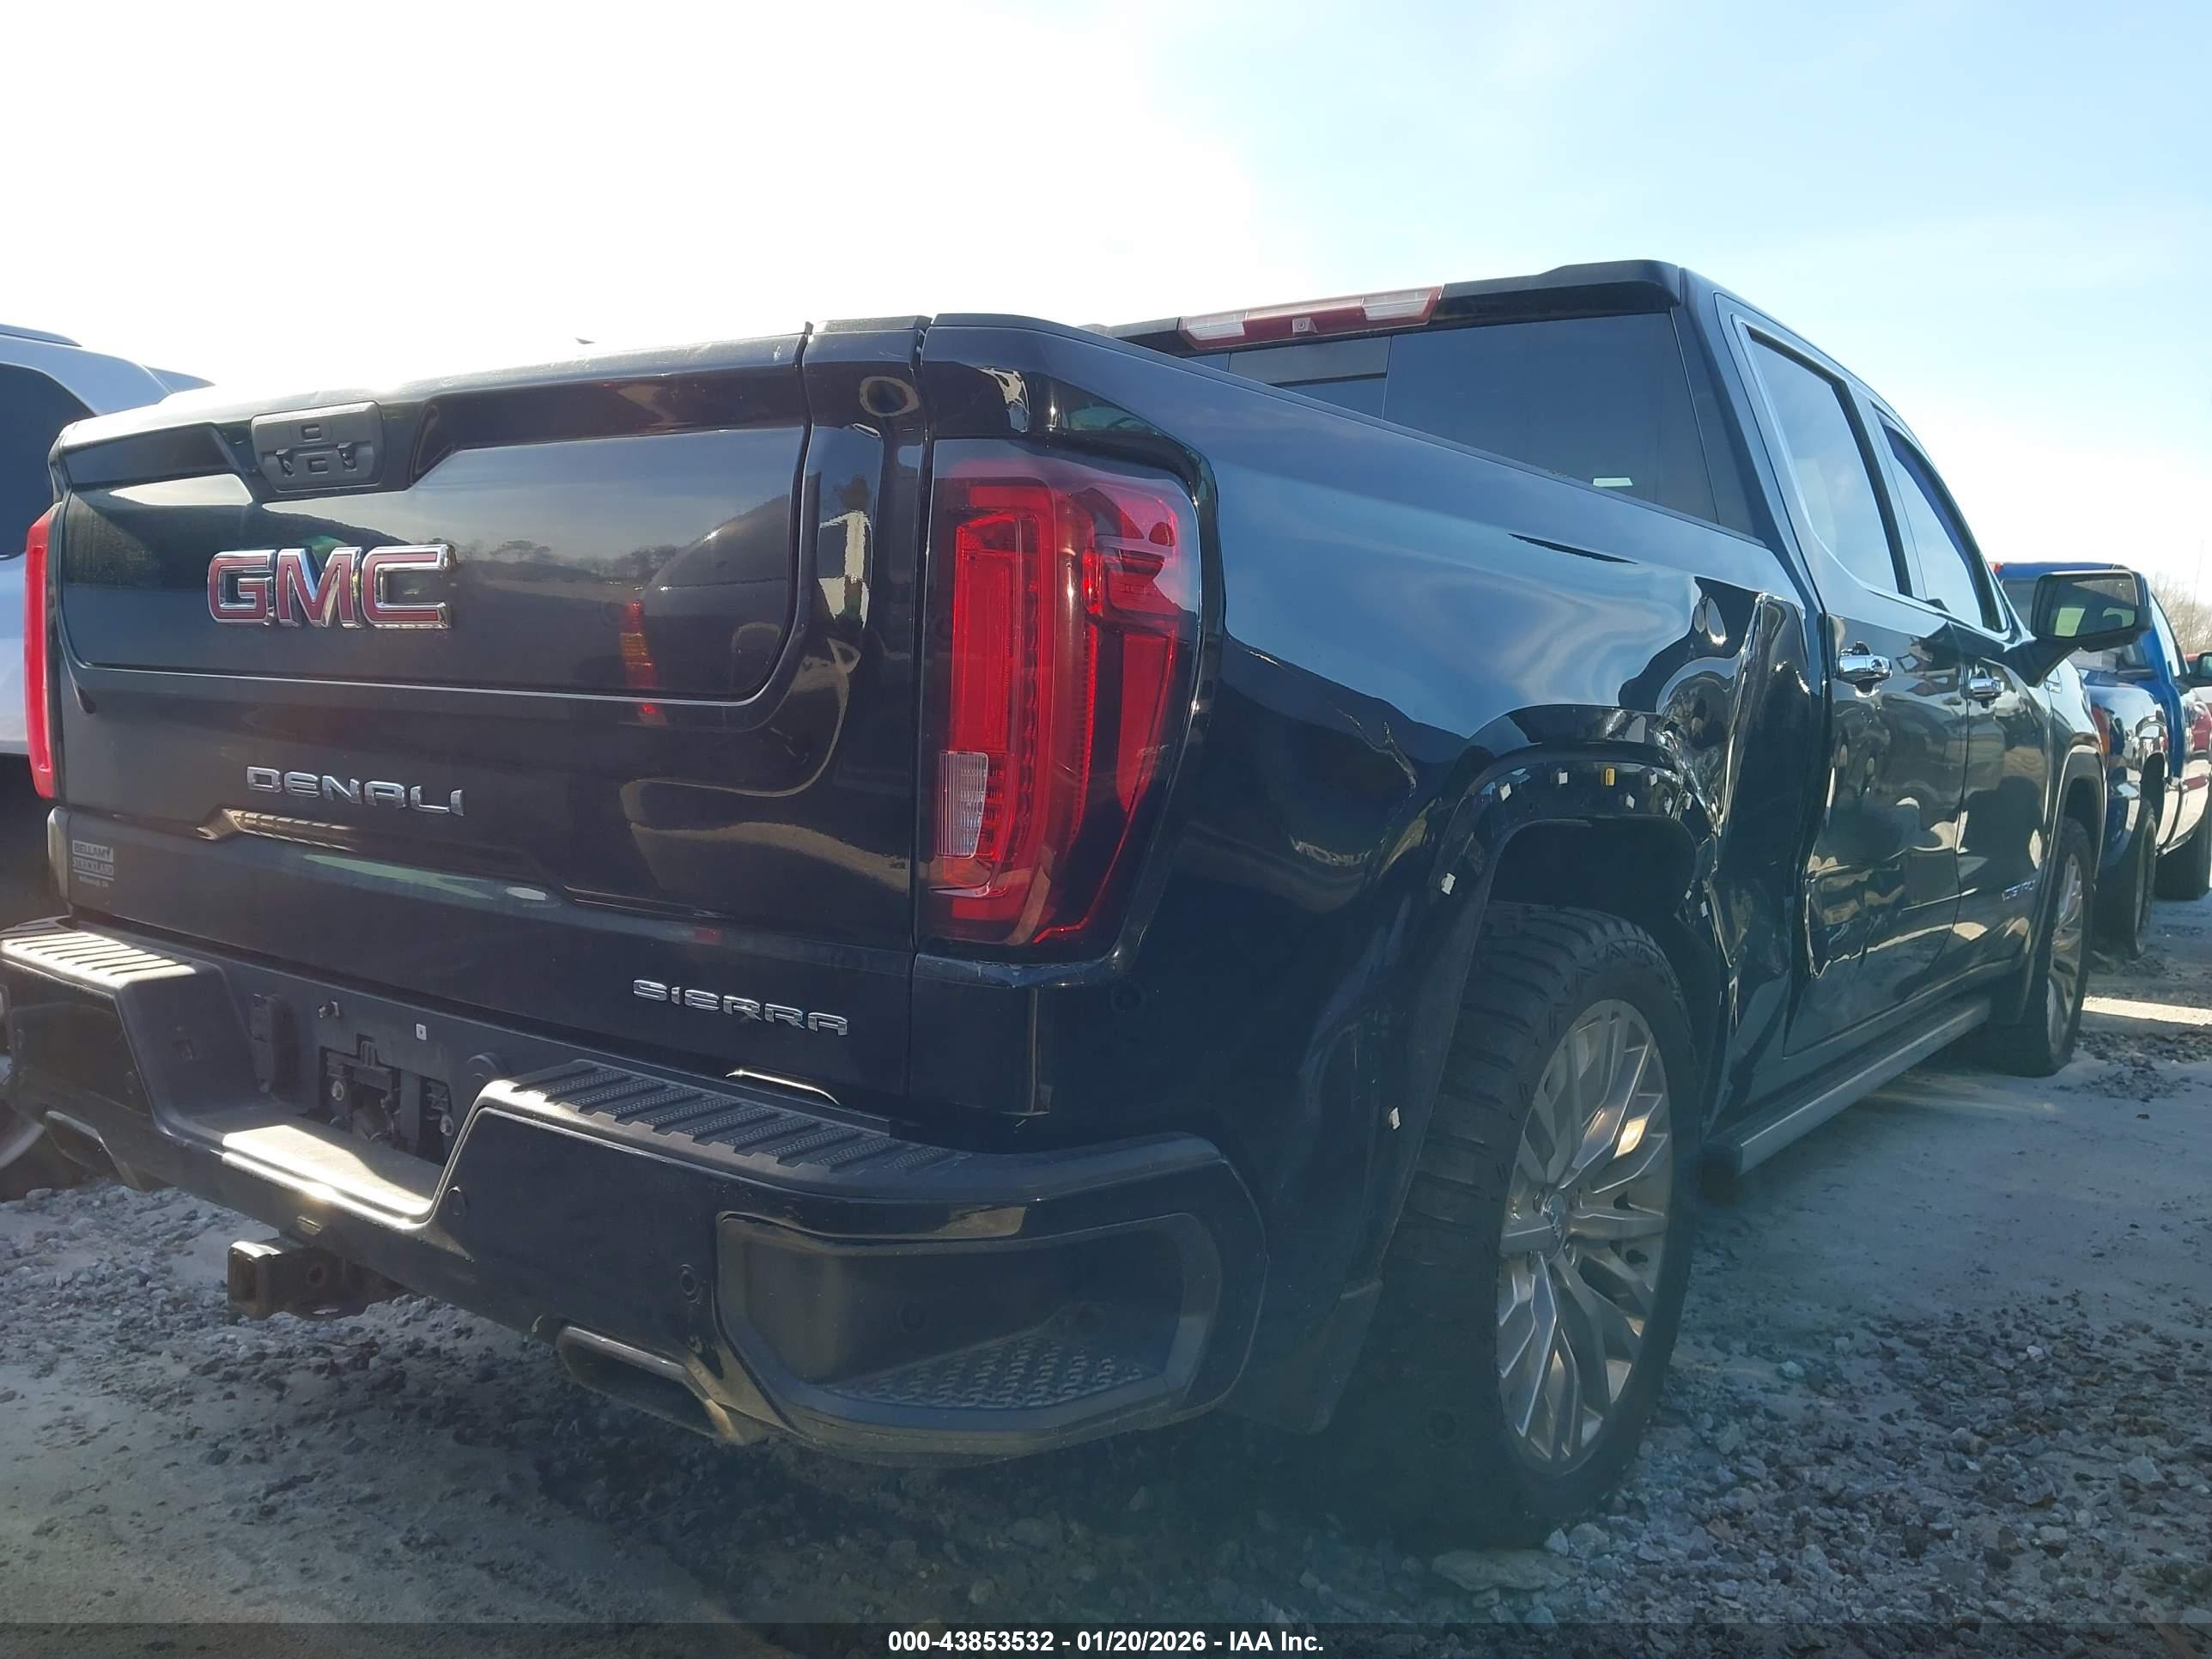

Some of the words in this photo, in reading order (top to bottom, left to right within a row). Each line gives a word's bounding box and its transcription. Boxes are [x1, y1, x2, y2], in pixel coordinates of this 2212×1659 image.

[208, 544, 457, 629] GMC
[246, 766, 465, 817] DENALI
[633, 979, 848, 1036] SIERRA
